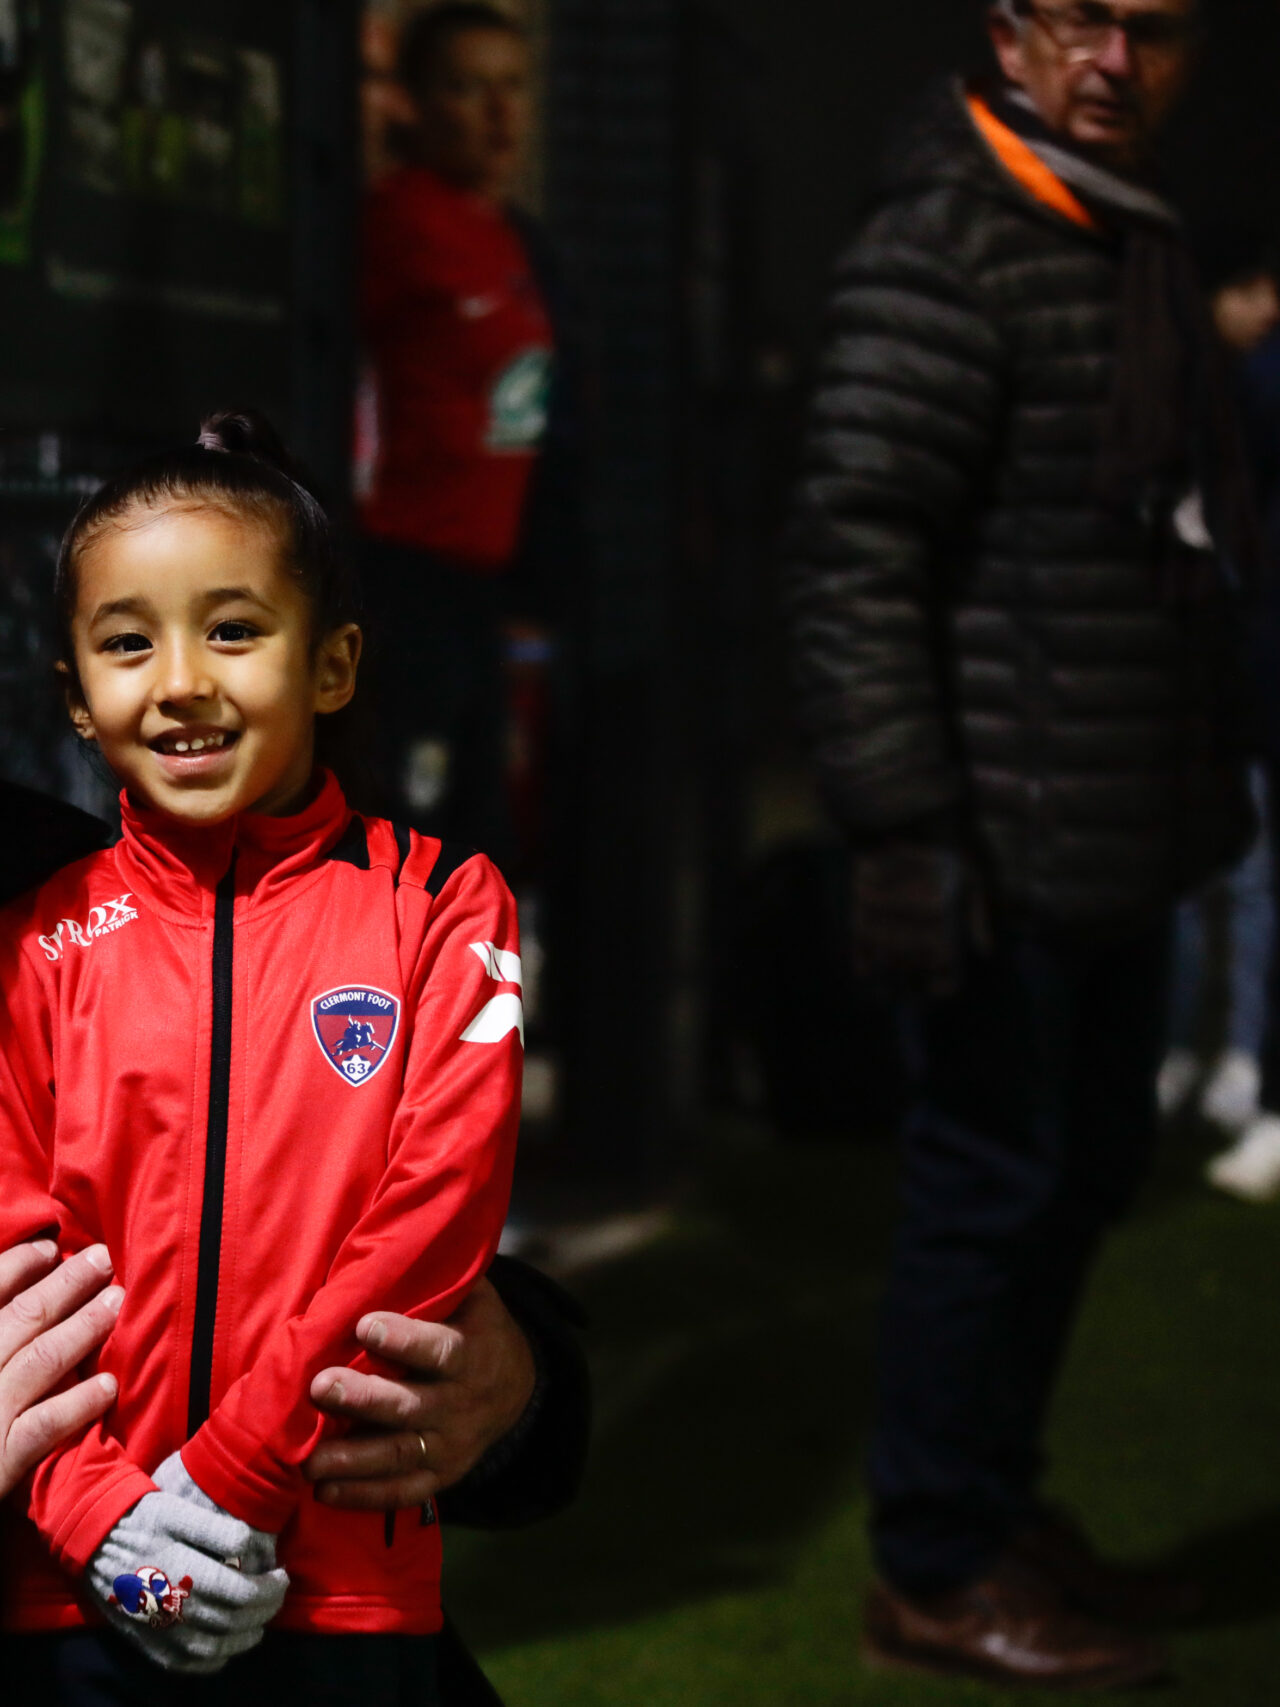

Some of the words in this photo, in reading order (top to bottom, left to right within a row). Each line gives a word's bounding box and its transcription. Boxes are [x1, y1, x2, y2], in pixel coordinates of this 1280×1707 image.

[94, 911, 139, 937] PATRICK
[320, 991, 367, 1010] CLERMONT
[367, 993, 392, 1010] FOOT
[346, 1063, 366, 1074] 63
